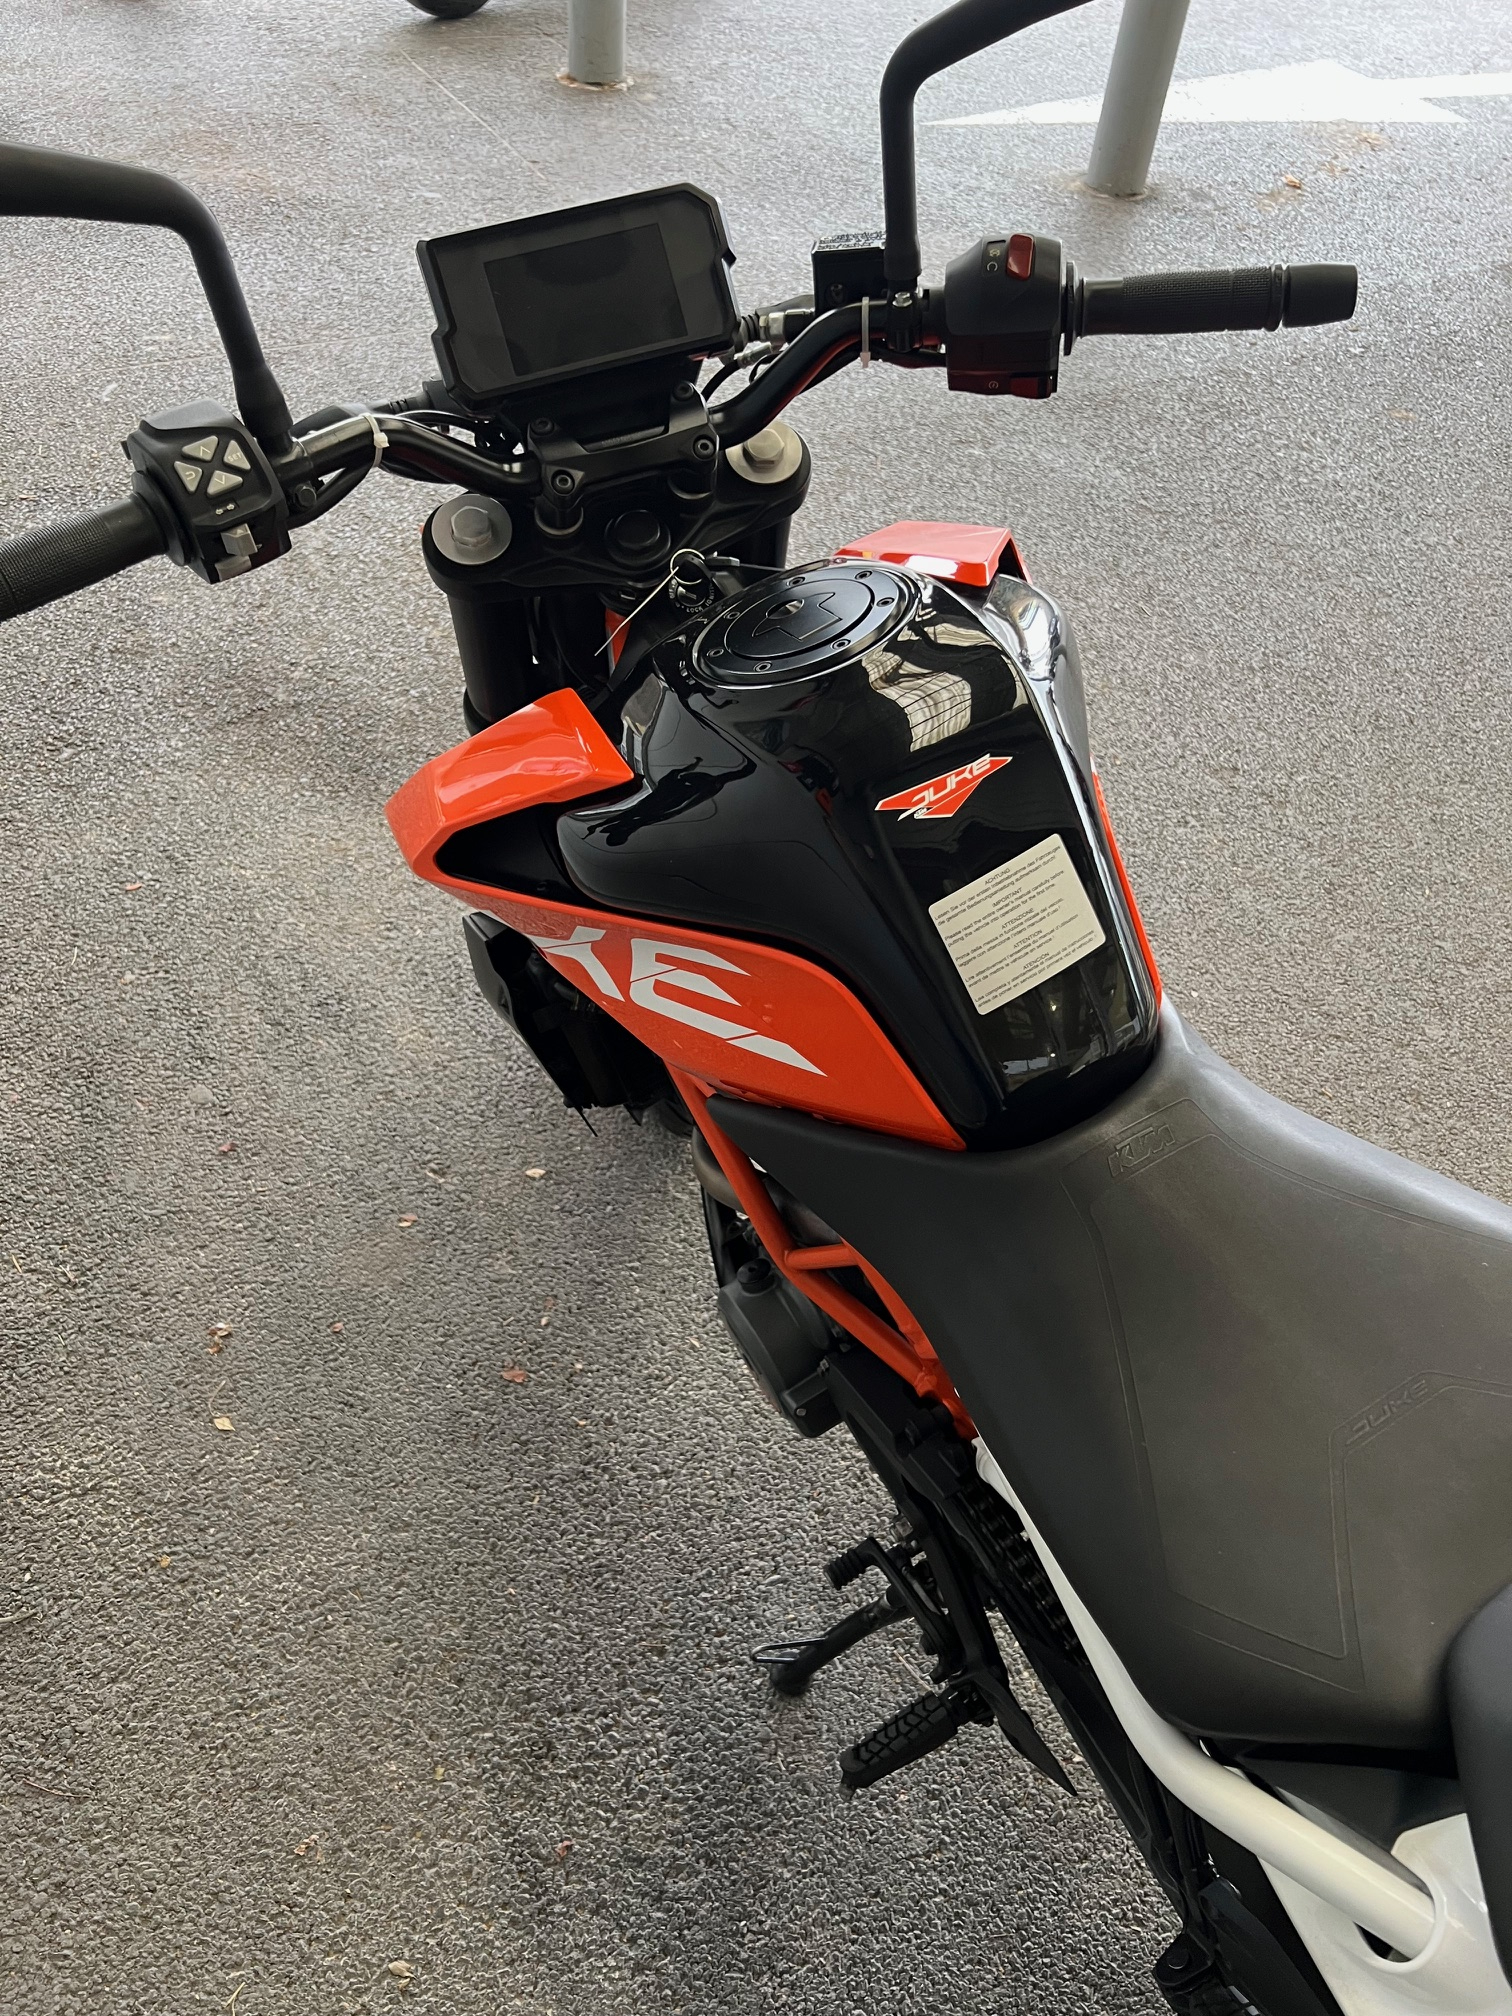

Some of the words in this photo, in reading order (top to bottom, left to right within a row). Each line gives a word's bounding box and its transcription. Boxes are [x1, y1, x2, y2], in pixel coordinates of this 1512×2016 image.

[227, 452, 241, 462] SET
[897, 753, 991, 821] DUKE
[991, 886, 1022, 908] IMPORTANT
[1012, 928, 1042, 949] ATTENTION
[1107, 1124, 1176, 1178] KTM
[1345, 1379, 1428, 1446] DUKE
